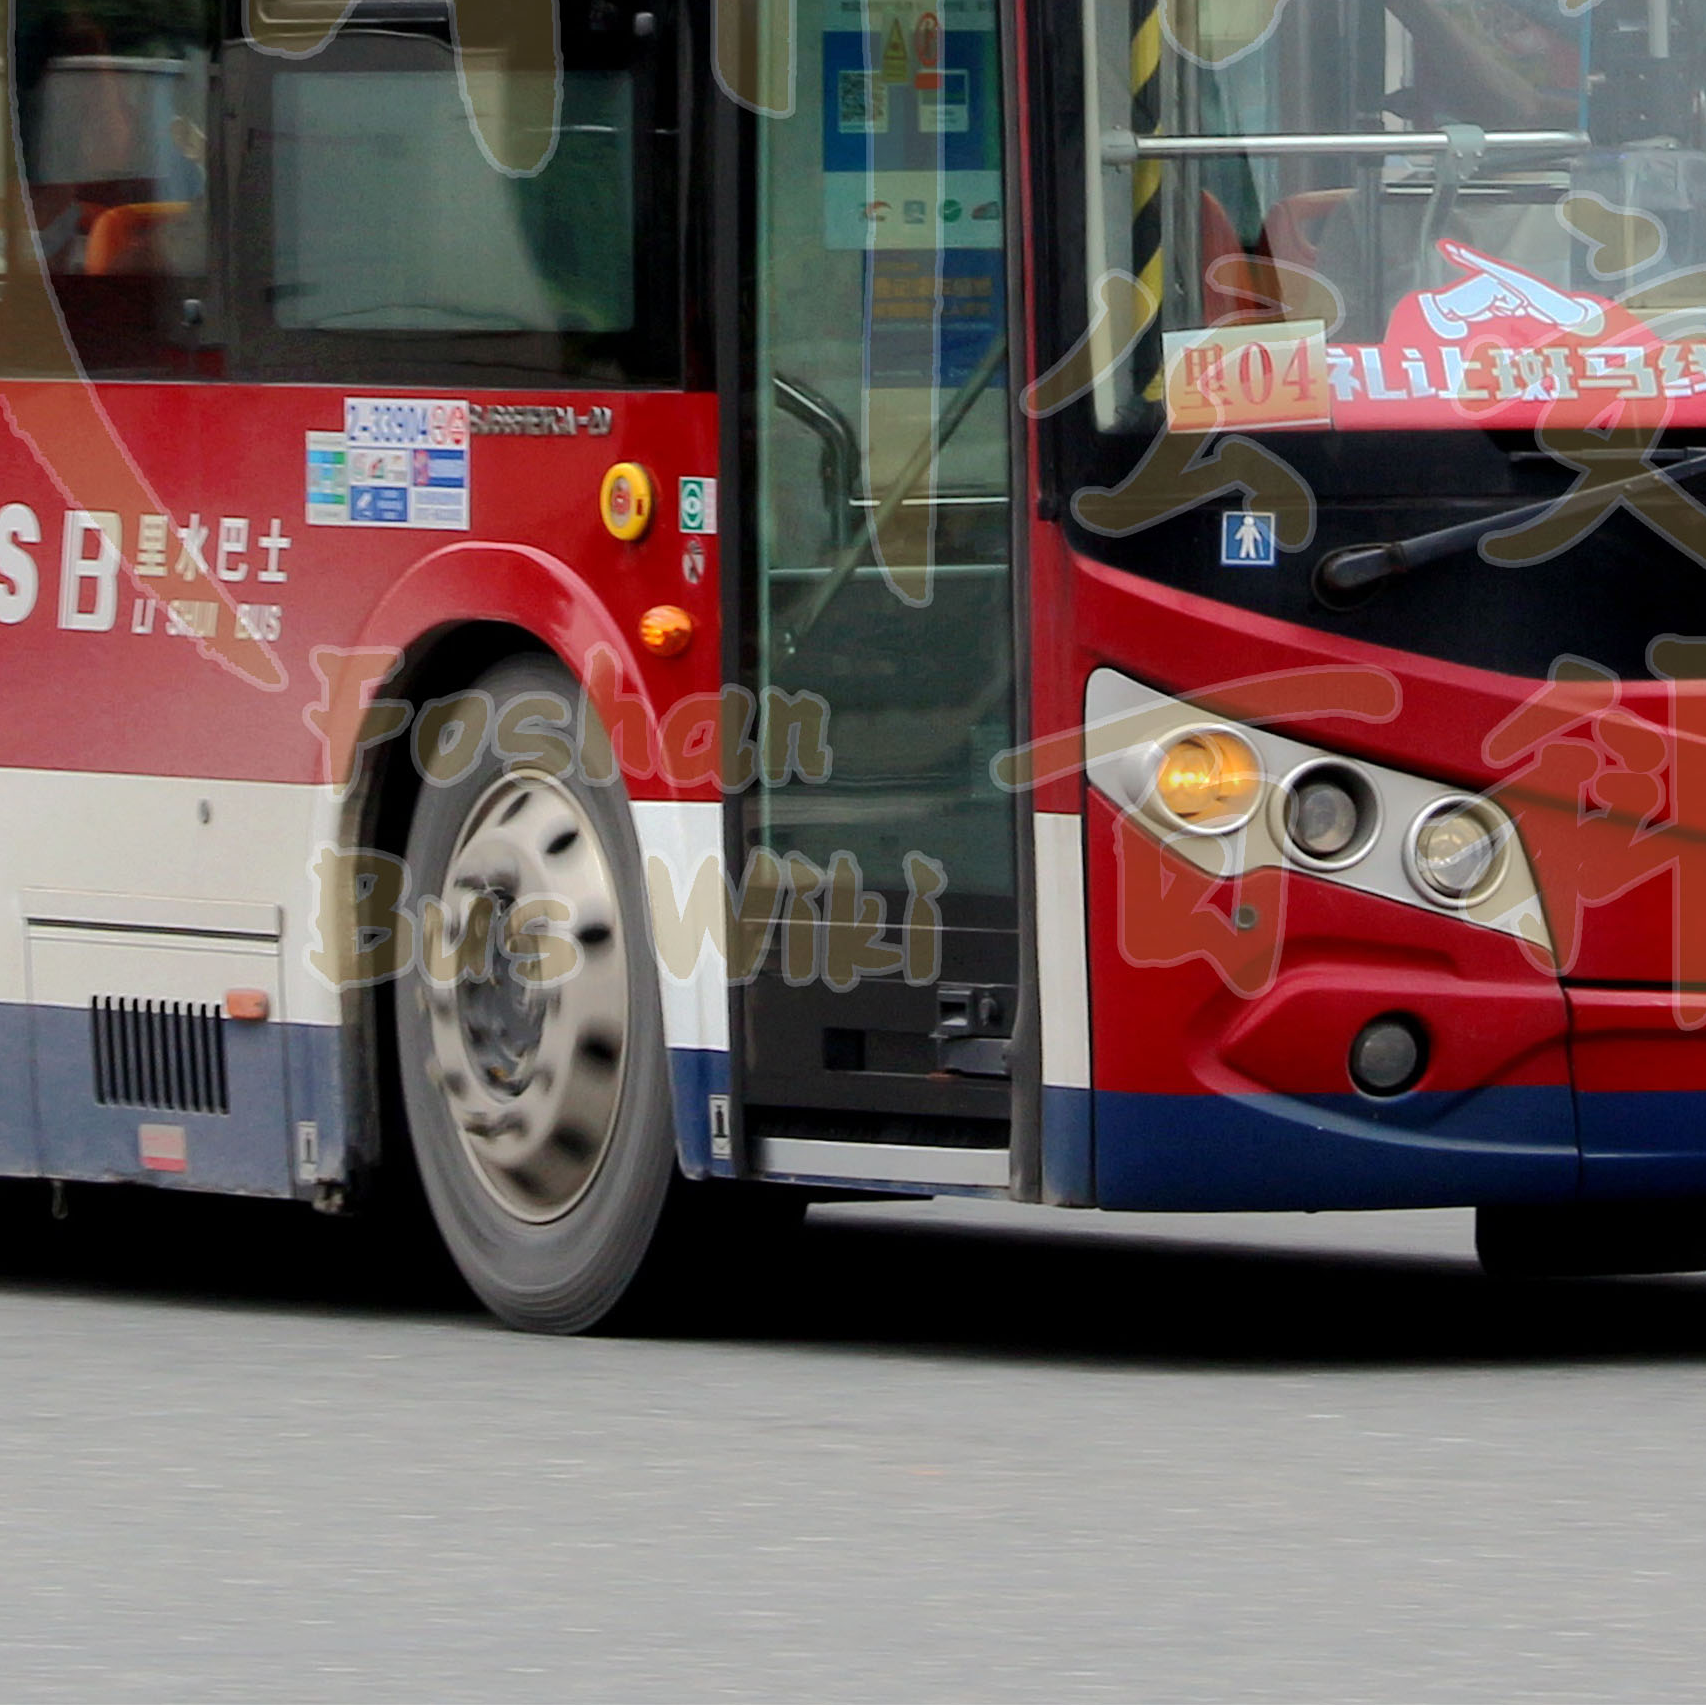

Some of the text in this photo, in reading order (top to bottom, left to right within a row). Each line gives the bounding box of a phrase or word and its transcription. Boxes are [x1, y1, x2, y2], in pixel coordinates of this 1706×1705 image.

[1179, 339, 1320, 412] 里04
[133, 512, 292, 583] 里水巴士
[234, 603, 283, 642] BUS
